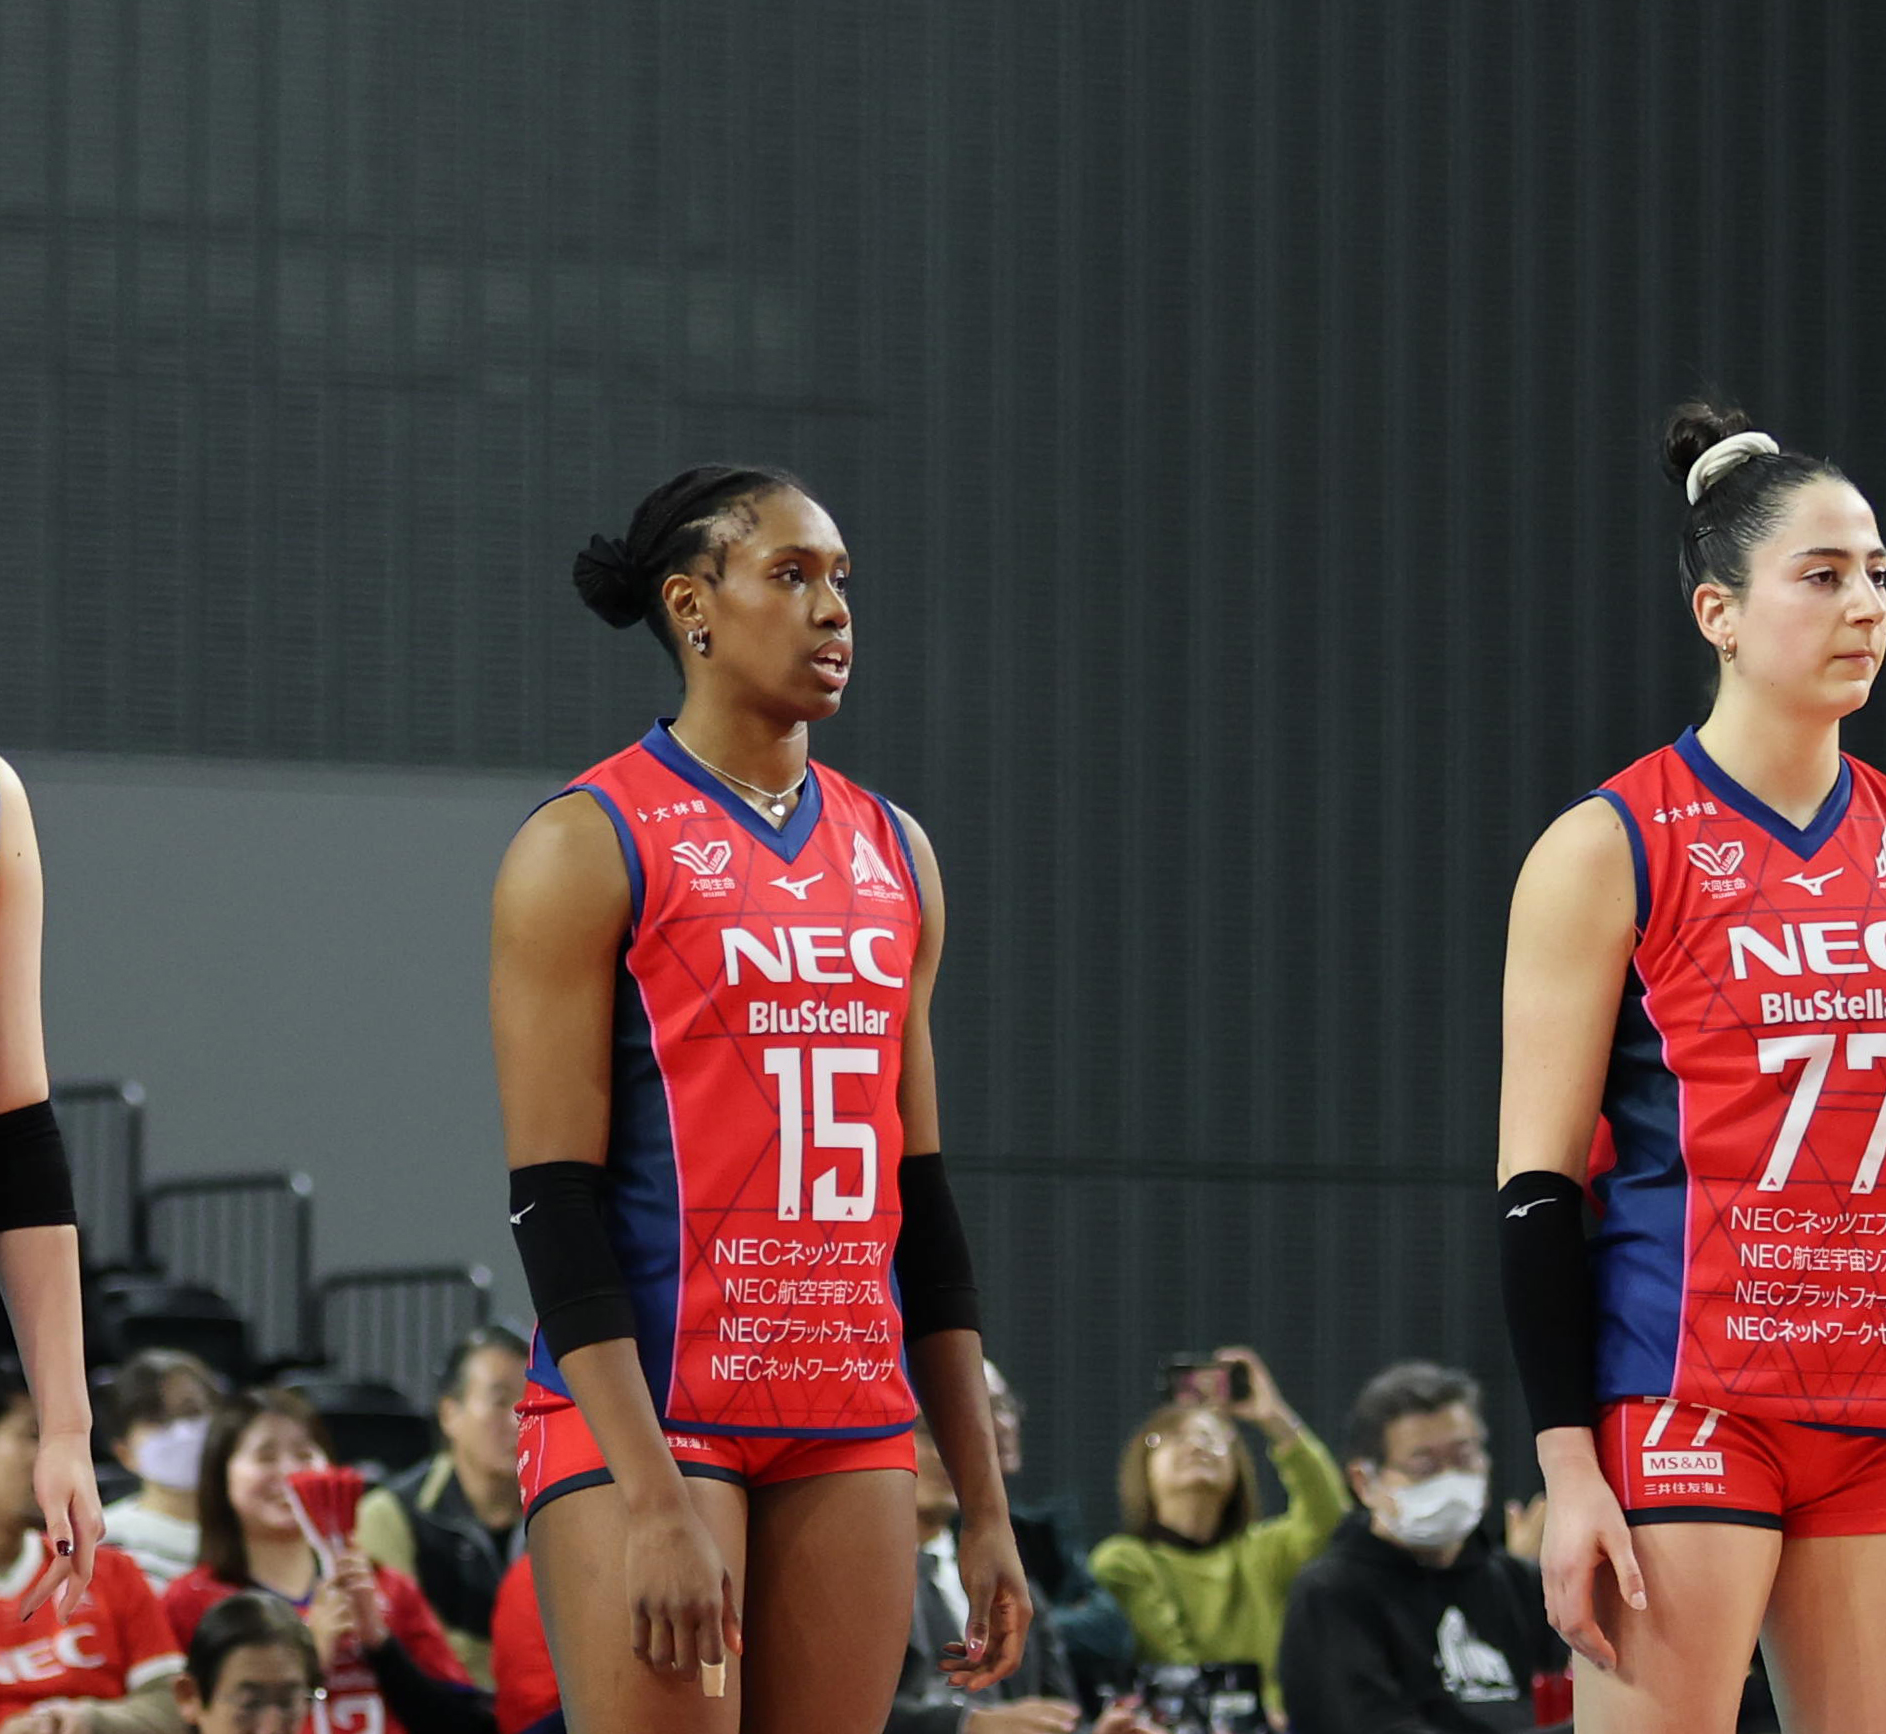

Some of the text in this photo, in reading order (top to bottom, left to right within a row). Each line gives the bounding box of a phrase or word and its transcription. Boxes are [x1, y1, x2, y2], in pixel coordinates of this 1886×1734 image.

[1700, 877, 1746, 893] 大同生命
[720, 926, 904, 988] NEC
[748, 999, 890, 1035] BluStellar
[763, 1047, 879, 1222] 15
[1650, 1456, 1718, 1470] MS&AD
[1644, 1482, 1726, 1496] 三井住友海上
